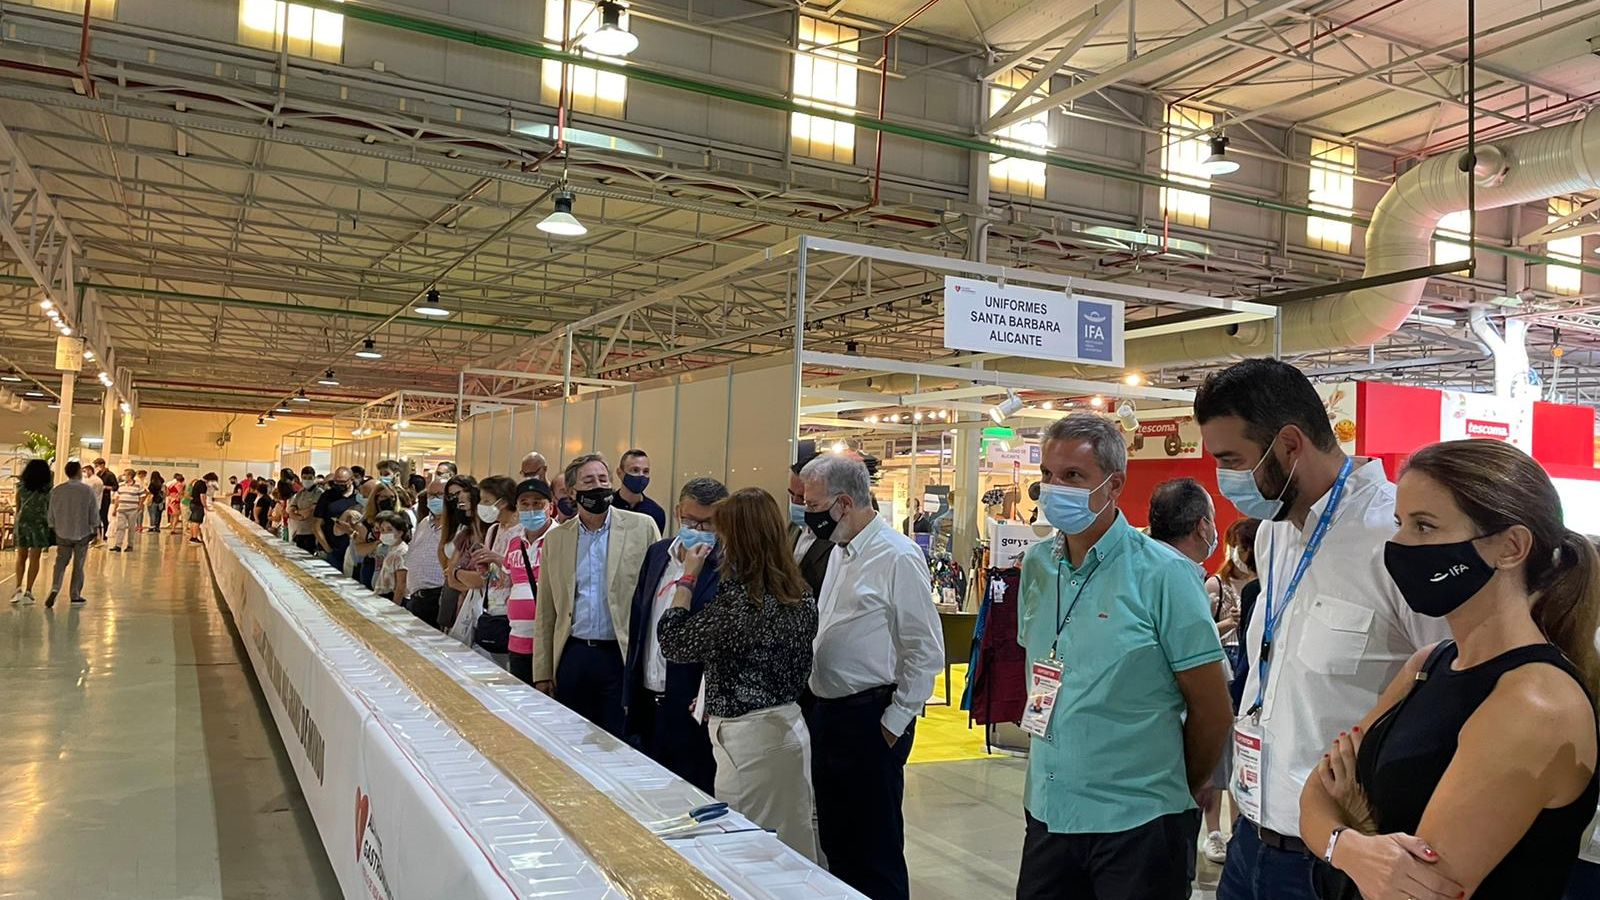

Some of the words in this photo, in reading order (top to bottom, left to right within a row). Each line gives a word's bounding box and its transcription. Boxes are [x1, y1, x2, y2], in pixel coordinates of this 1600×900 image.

[985, 296, 1047, 315] UNIFORMES
[970, 310, 1007, 326] SANTA
[1008, 315, 1061, 333] BARBARA
[989, 330, 1042, 347] ALICANTE
[1084, 324, 1105, 340] IFA
[1001, 538, 1029, 547] gary's
[1449, 563, 1469, 576] IFA
